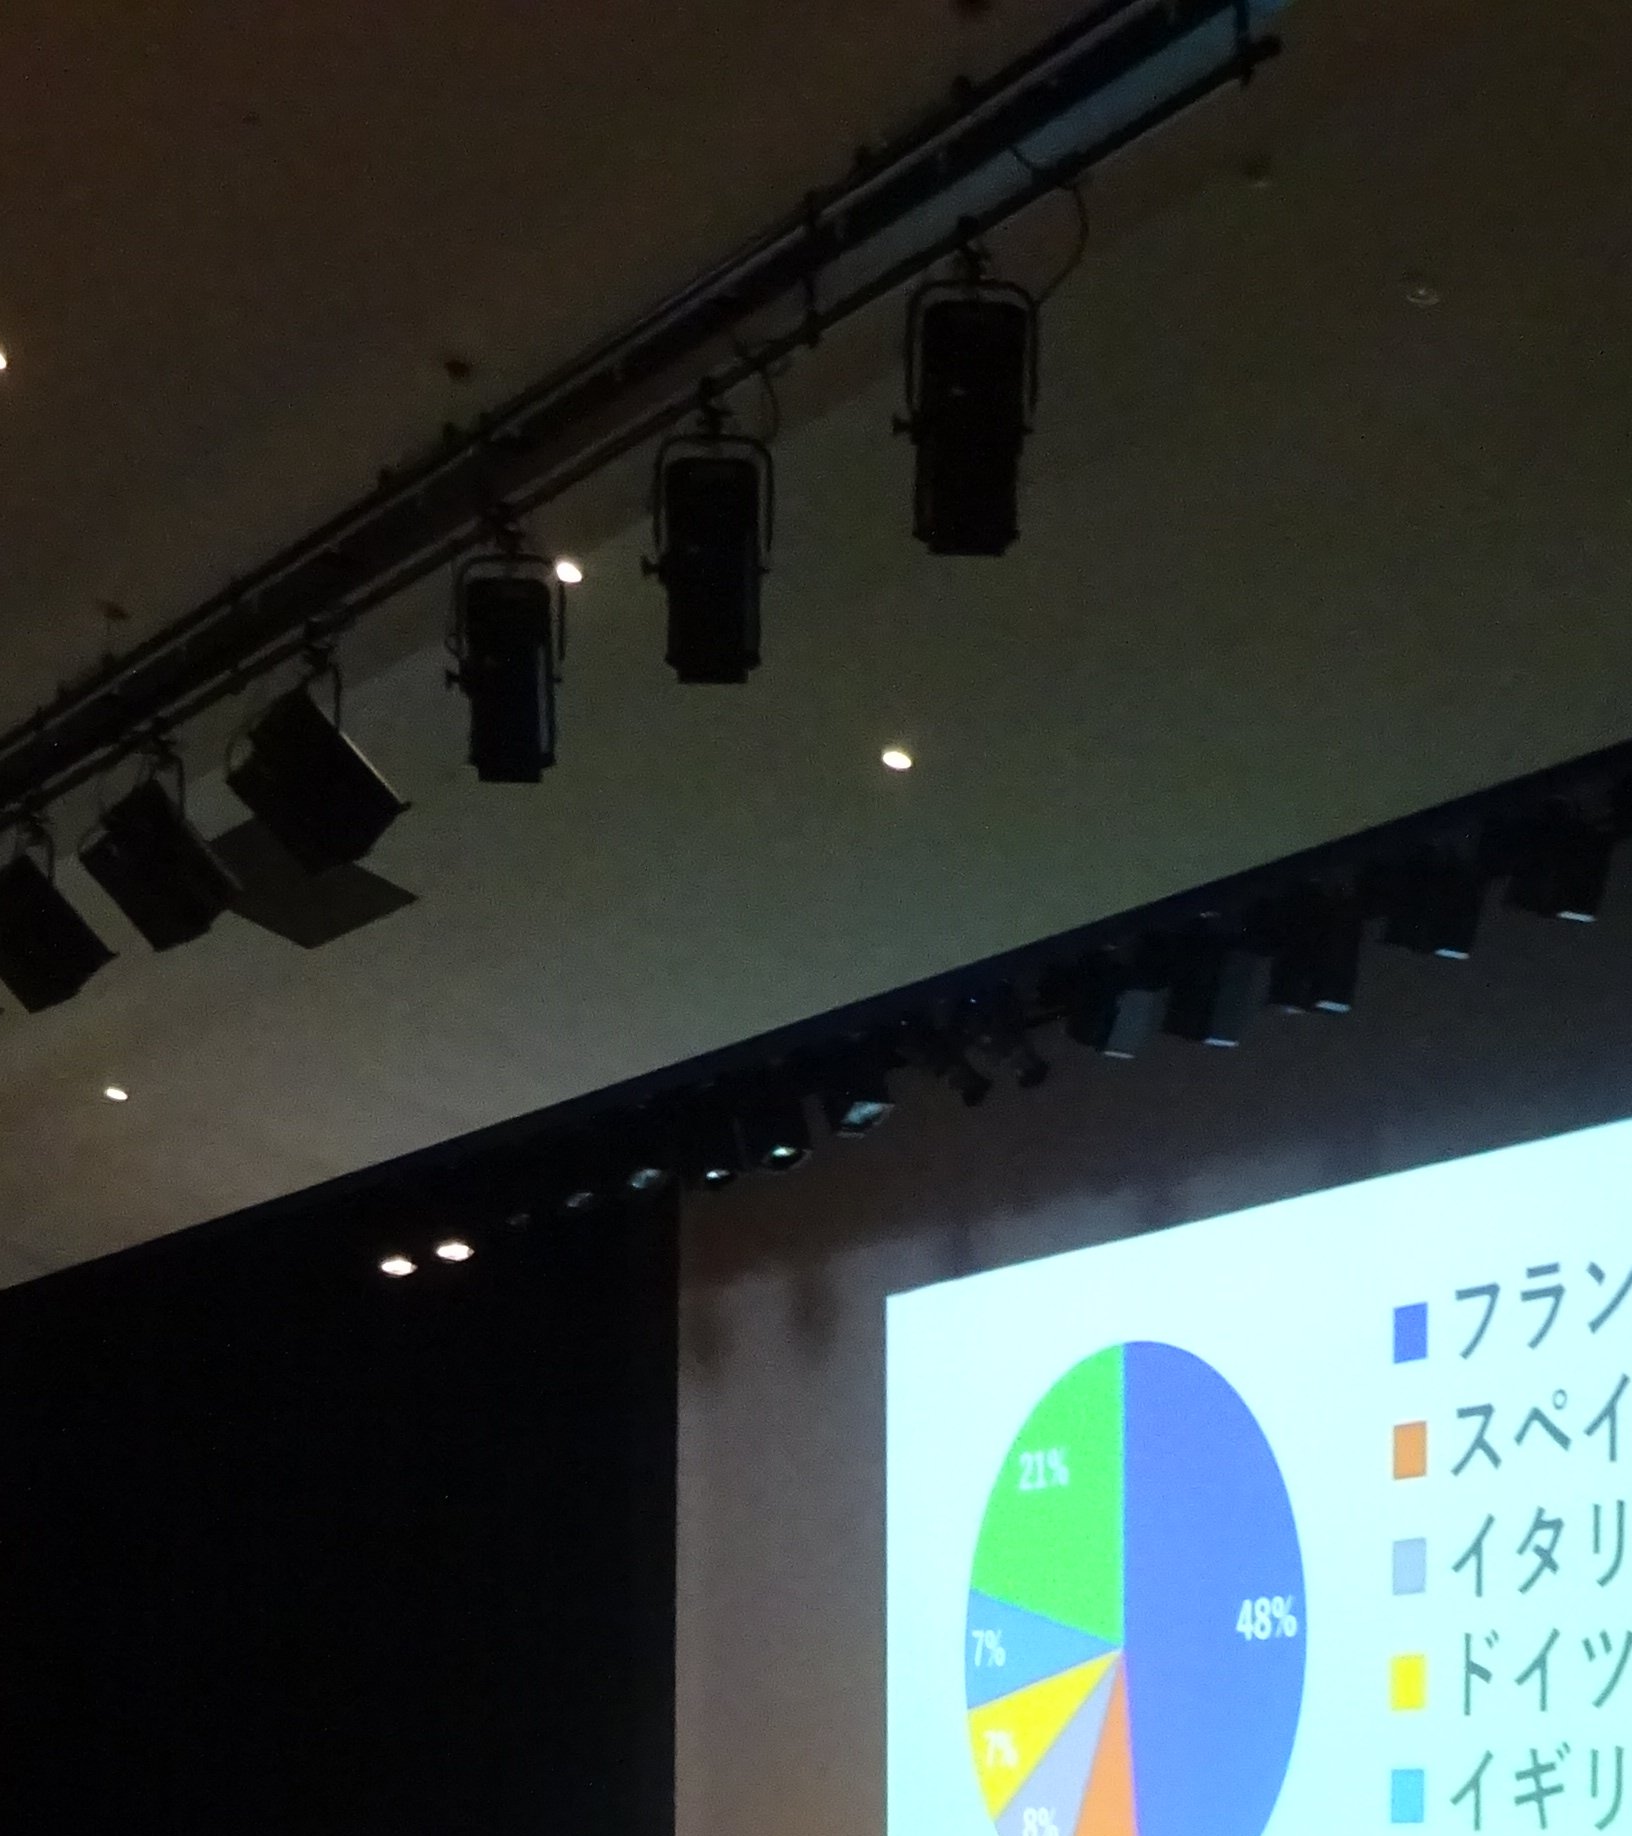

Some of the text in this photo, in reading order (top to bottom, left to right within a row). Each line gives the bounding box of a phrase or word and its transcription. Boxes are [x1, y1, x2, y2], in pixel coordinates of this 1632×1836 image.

[1019, 1448, 1068, 1491] 21%
[1236, 1596, 1298, 1642] 48%
[971, 1630, 1006, 1667] 7%
[983, 1729, 1021, 1768] 7%
